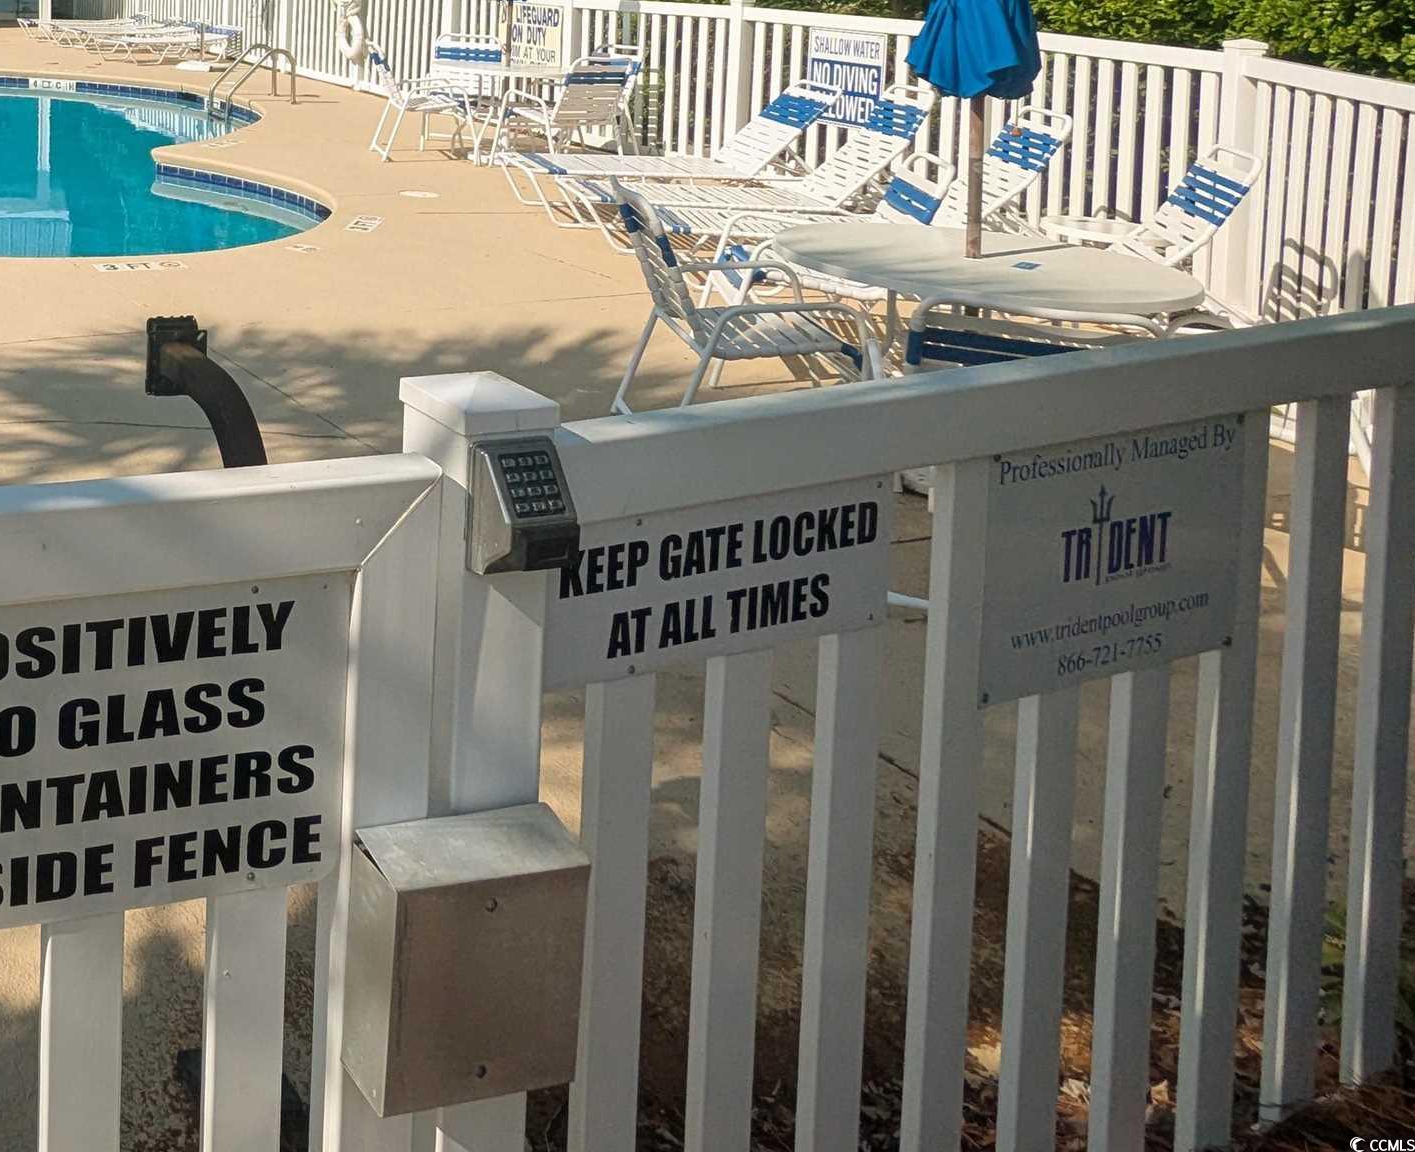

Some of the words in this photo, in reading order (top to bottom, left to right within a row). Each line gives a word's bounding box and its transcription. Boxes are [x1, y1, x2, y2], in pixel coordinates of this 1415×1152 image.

[513, 24, 523, 43] ON
[527, 26, 547, 46] DUTY
[516, 5, 559, 27] LIFEGUARD
[523, 46, 533, 59] AT
[536, 48, 555, 63] YOUR
[814, 35, 852, 55] SHALLOW
[853, 40, 880, 59] WATER
[813, 61, 830, 86] NO
[833, 63, 878, 95] DIVING
[822, 92, 874, 123] LOWED
[1000, 443, 1123, 486] Professionally
[1131, 425, 1207, 461] Managed
[1213, 423, 1236, 452] By
[559, 540, 649, 599] KEEP
[659, 523, 744, 581] GATE
[752, 500, 878, 564] LOCKED
[607, 606, 653, 659] AT
[659, 594, 717, 649] ALL
[726, 573, 831, 634] TIMES
[1011, 592, 1210, 649] www.tridentpoolgroup.com
[1057, 632, 1162, 677] 866-721-7755
[58, 677, 265, 750] GLASS
[133, 814, 322, 889] FENCE
